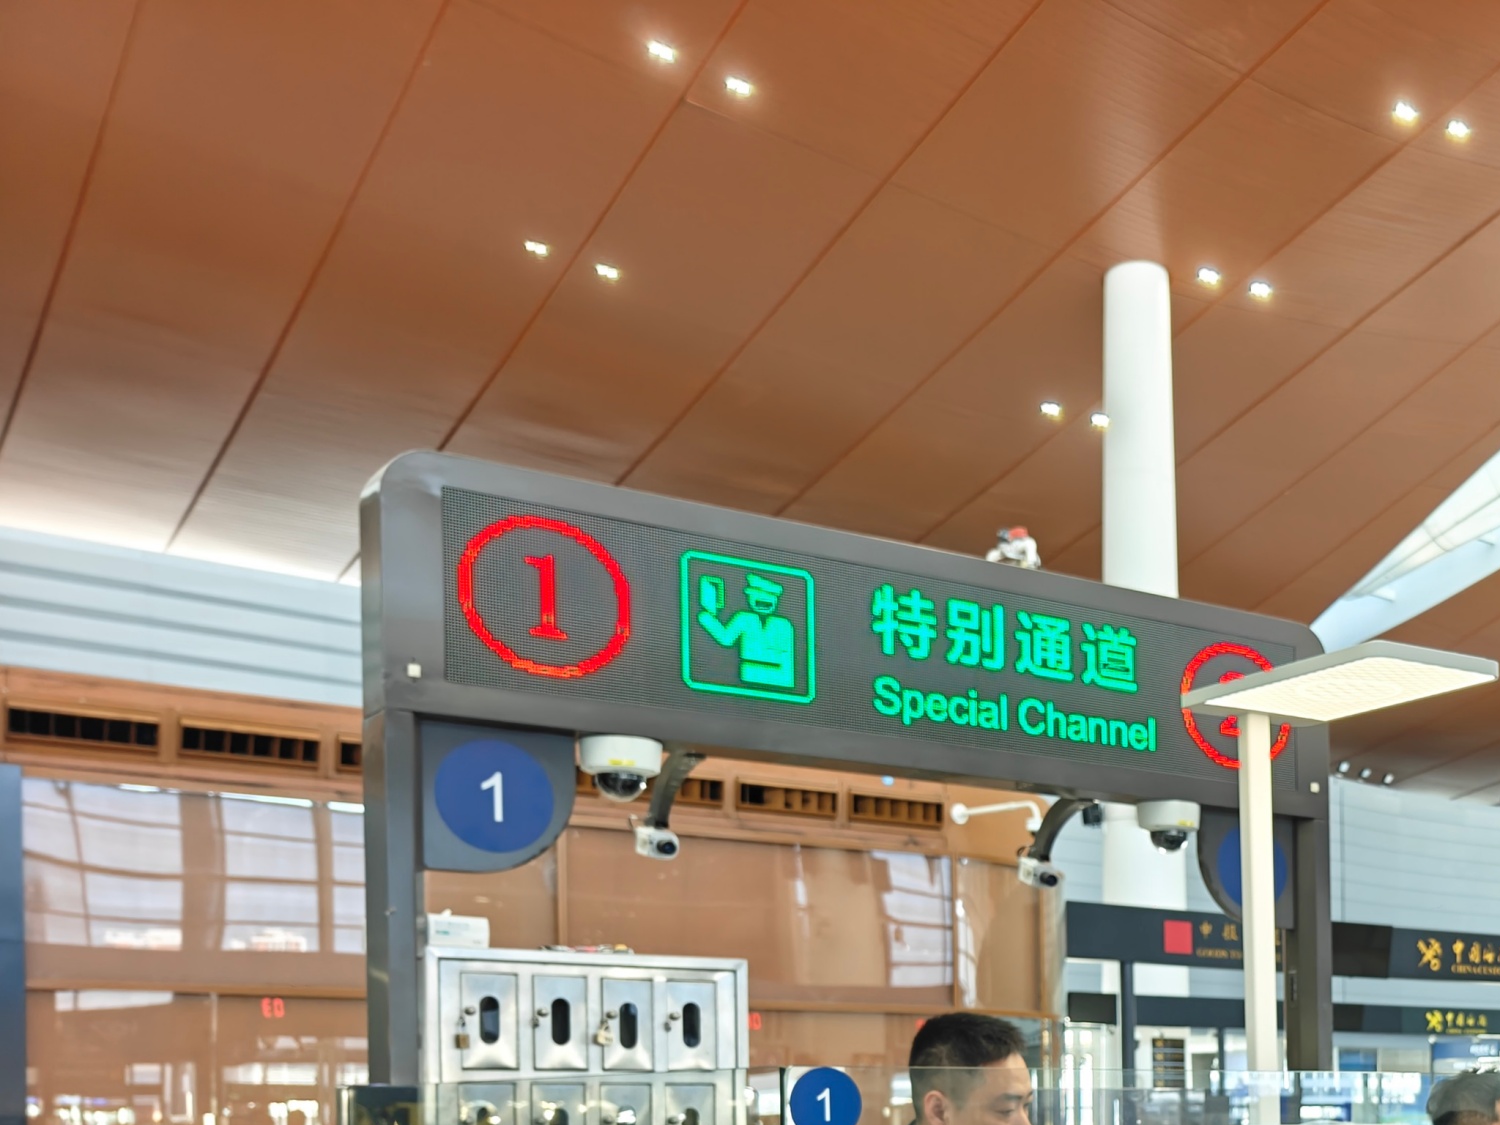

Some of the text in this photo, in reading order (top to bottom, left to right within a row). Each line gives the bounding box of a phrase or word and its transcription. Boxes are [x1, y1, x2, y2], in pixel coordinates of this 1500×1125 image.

[872, 583, 1138, 694] 特别通道
[872, 675, 1008, 731] Special
[1018, 697, 1157, 752] Channel
[480, 771, 504, 823] 1
[817, 1087, 832, 1122] 1
